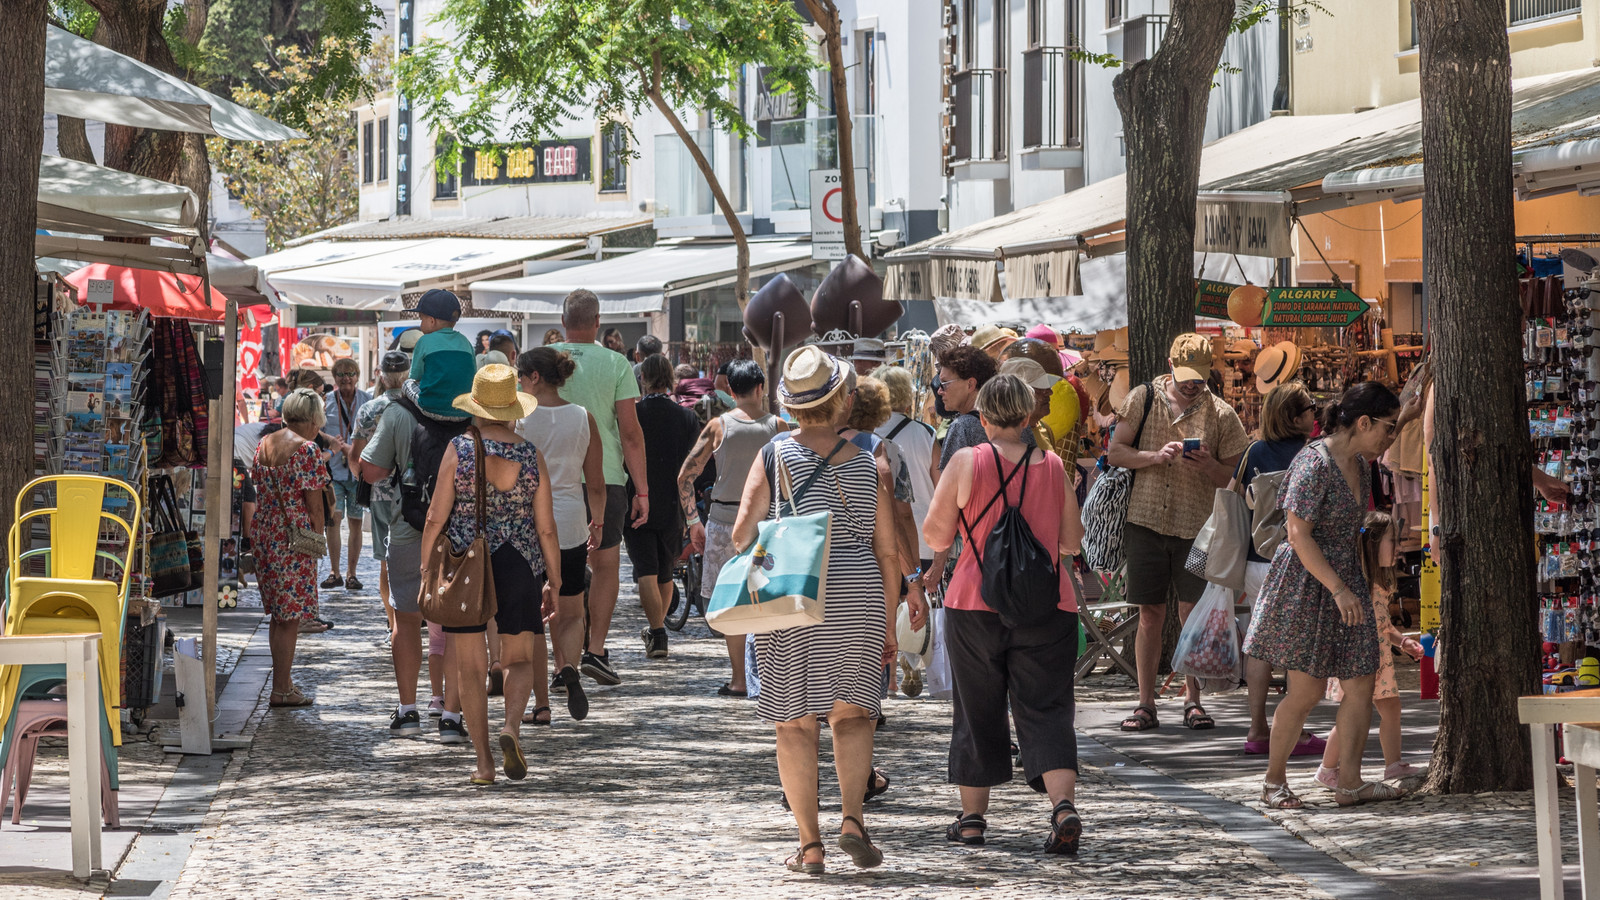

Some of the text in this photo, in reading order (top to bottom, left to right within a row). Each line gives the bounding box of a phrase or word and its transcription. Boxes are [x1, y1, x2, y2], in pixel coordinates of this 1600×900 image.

[397, 1, 409, 202] KAAOKE
[544, 146, 577, 176] BAR
[1278, 290, 1338, 299] ALGARVE
[1273, 302, 1361, 311] SUMO DE LARANJA NATURAL
[1273, 313, 1348, 322] NATURAL ORANGE JUICE
